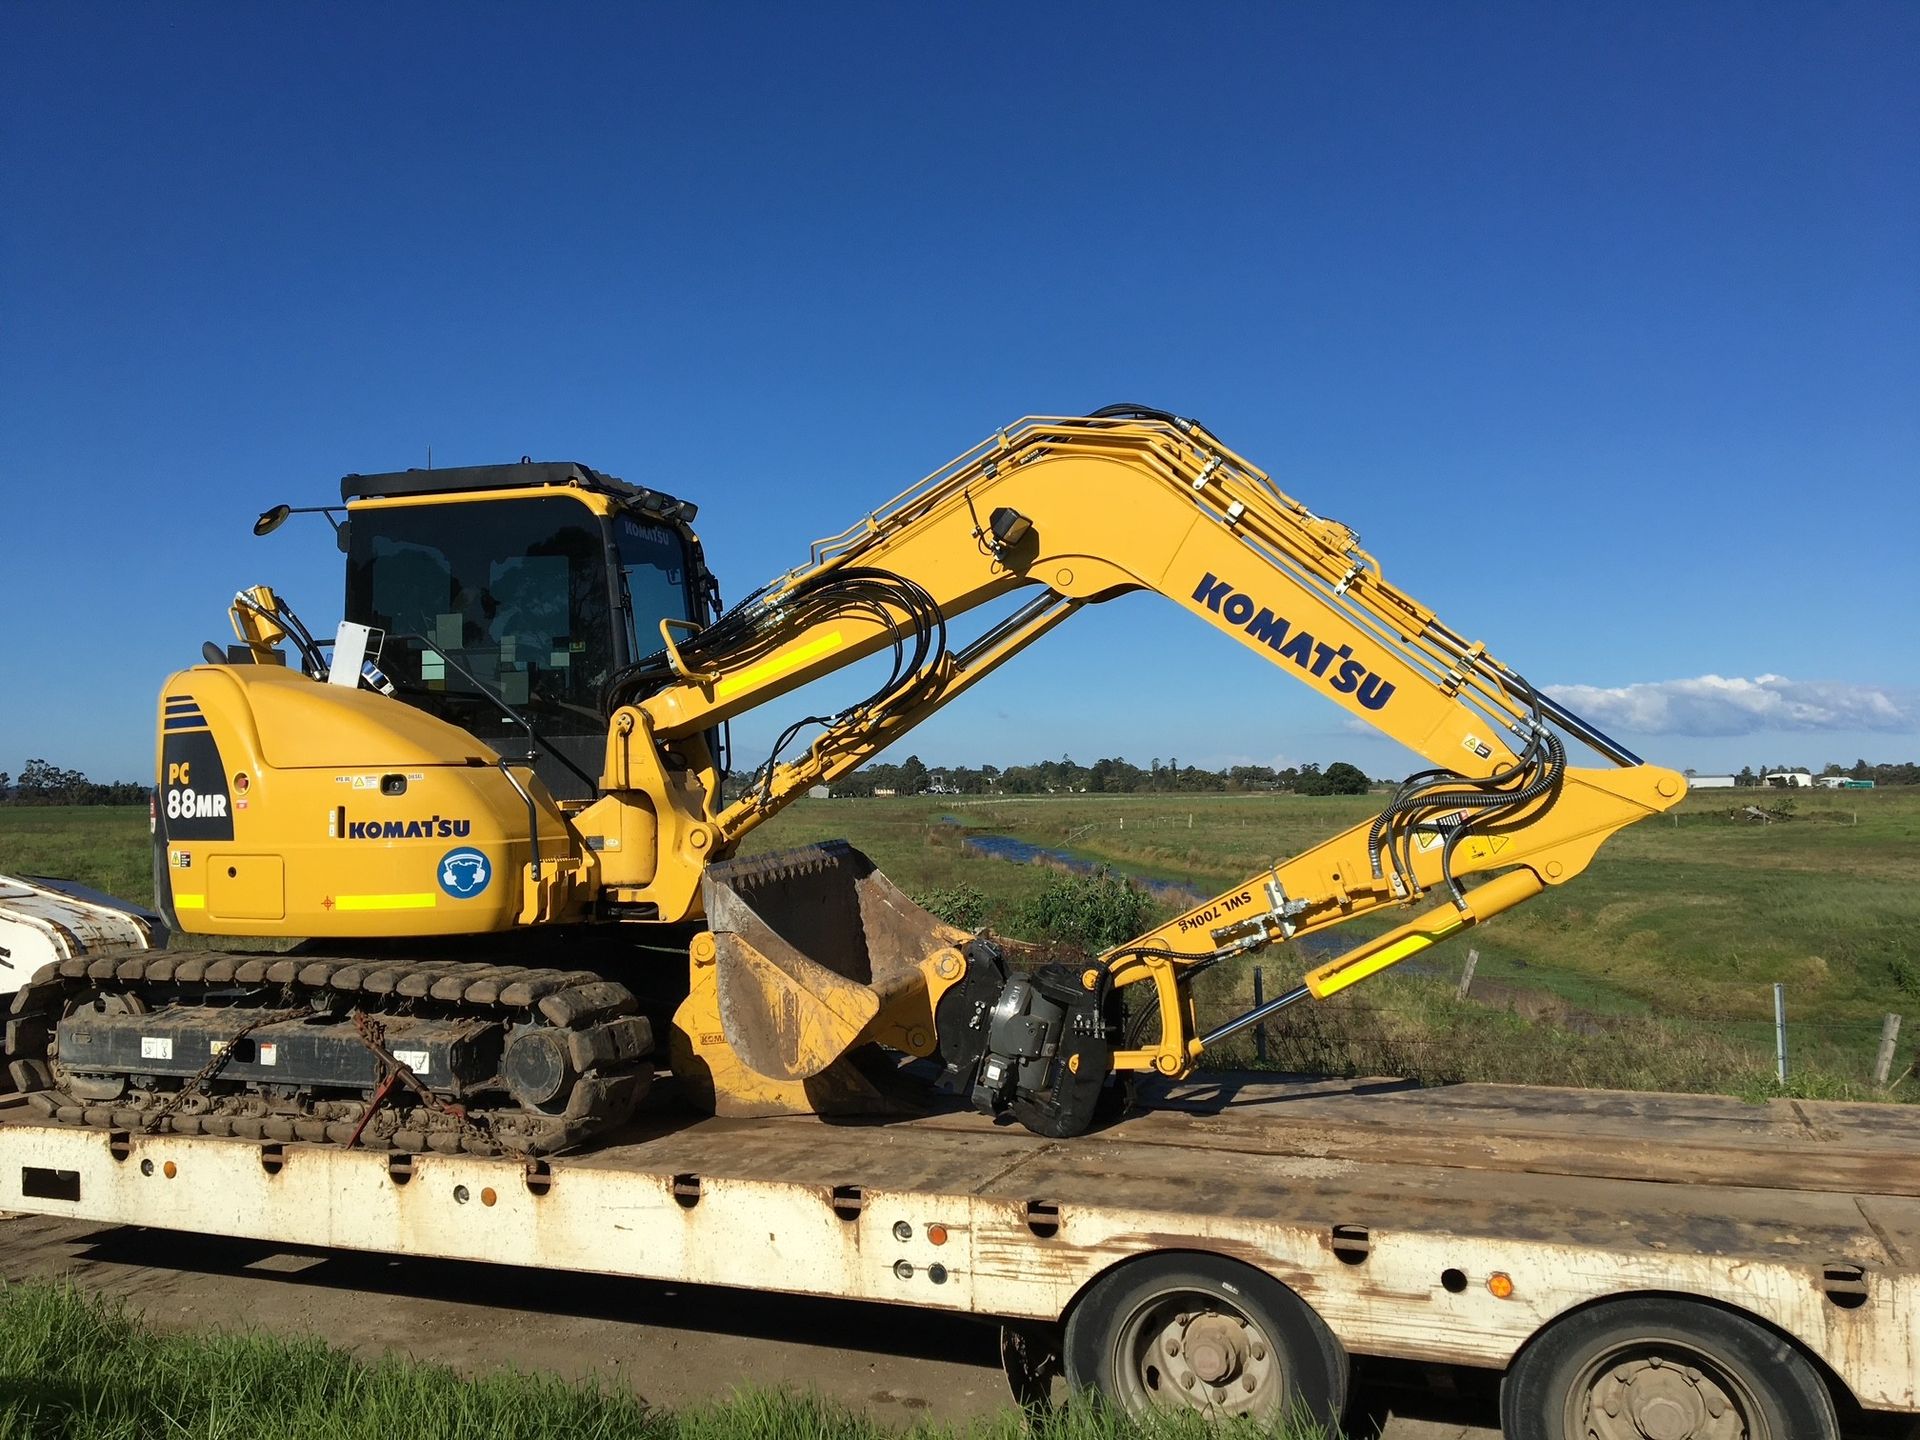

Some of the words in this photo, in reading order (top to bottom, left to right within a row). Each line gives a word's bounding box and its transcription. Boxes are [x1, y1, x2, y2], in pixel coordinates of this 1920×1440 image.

[624, 520, 670, 546] KOMATSU
[1190, 571, 1397, 710] KOMATSU
[168, 762, 190, 786] PC
[167, 788, 228, 819] 88MR
[349, 815, 471, 839] KOMATSU
[1220, 891, 1252, 912] SWL
[1178, 906, 1222, 934] 700kg
